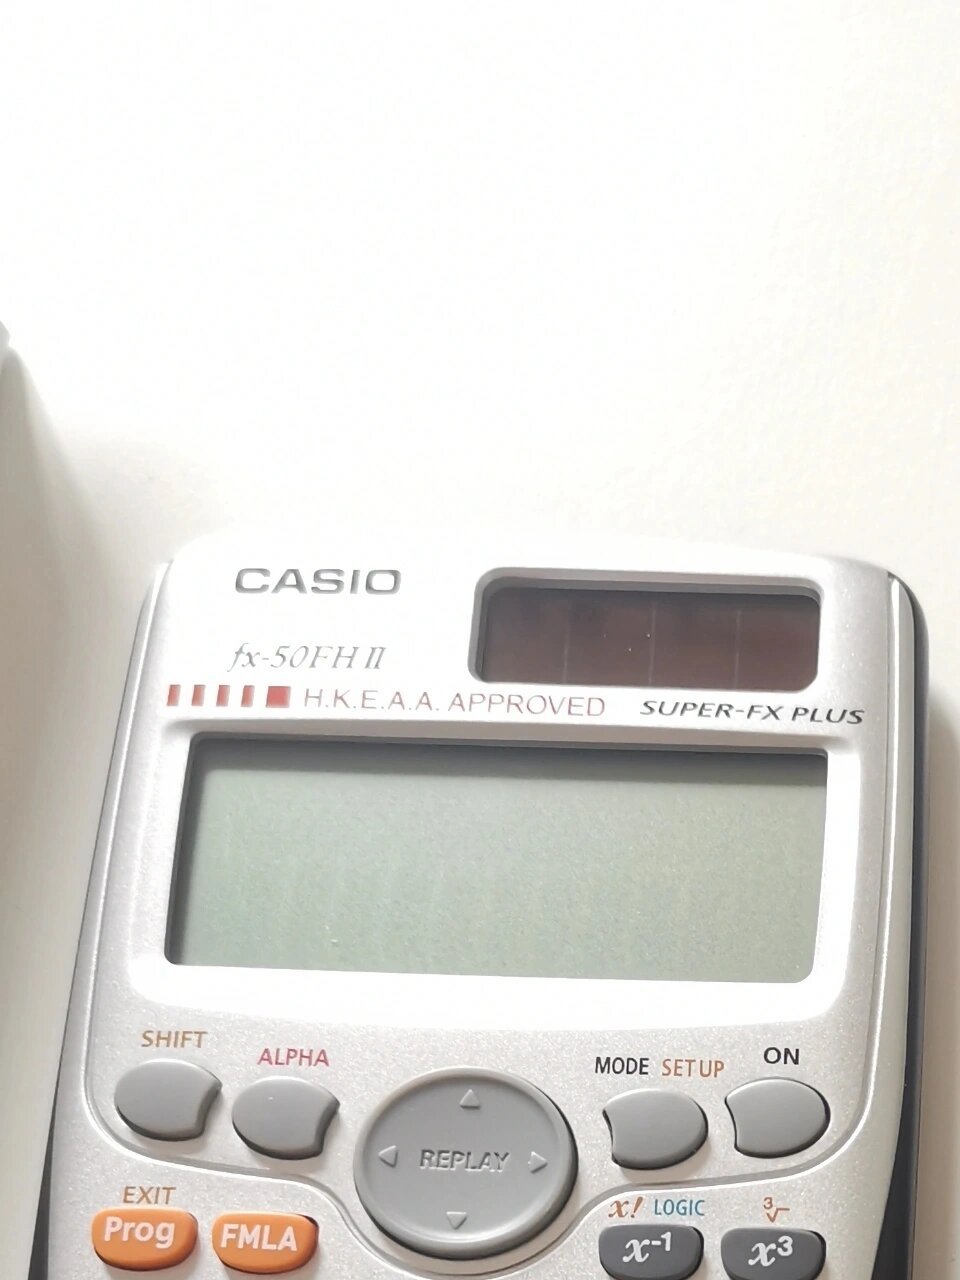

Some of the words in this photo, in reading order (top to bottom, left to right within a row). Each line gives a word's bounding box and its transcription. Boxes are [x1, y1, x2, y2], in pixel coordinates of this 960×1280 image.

[234, 567, 401, 596] CASIO
[303, 688, 442, 714] H.K.E.A.A.
[449, 692, 606, 717] APPROVED
[639, 700, 787, 722] SUPER-FX
[791, 704, 867, 726] PLUS
[141, 1030, 208, 1049] SHIFT
[257, 1048, 330, 1067] ALPHA
[595, 1056, 650, 1076] MODE
[662, 1058, 725, 1078] SETUP
[763, 1047, 800, 1065] ON
[419, 1149, 511, 1172] REPLAY
[123, 1186, 177, 1205] EXIT
[654, 1198, 705, 1217] LOGIC
[104, 1216, 175, 1249] Prog
[221, 1223, 298, 1251] FMLA
